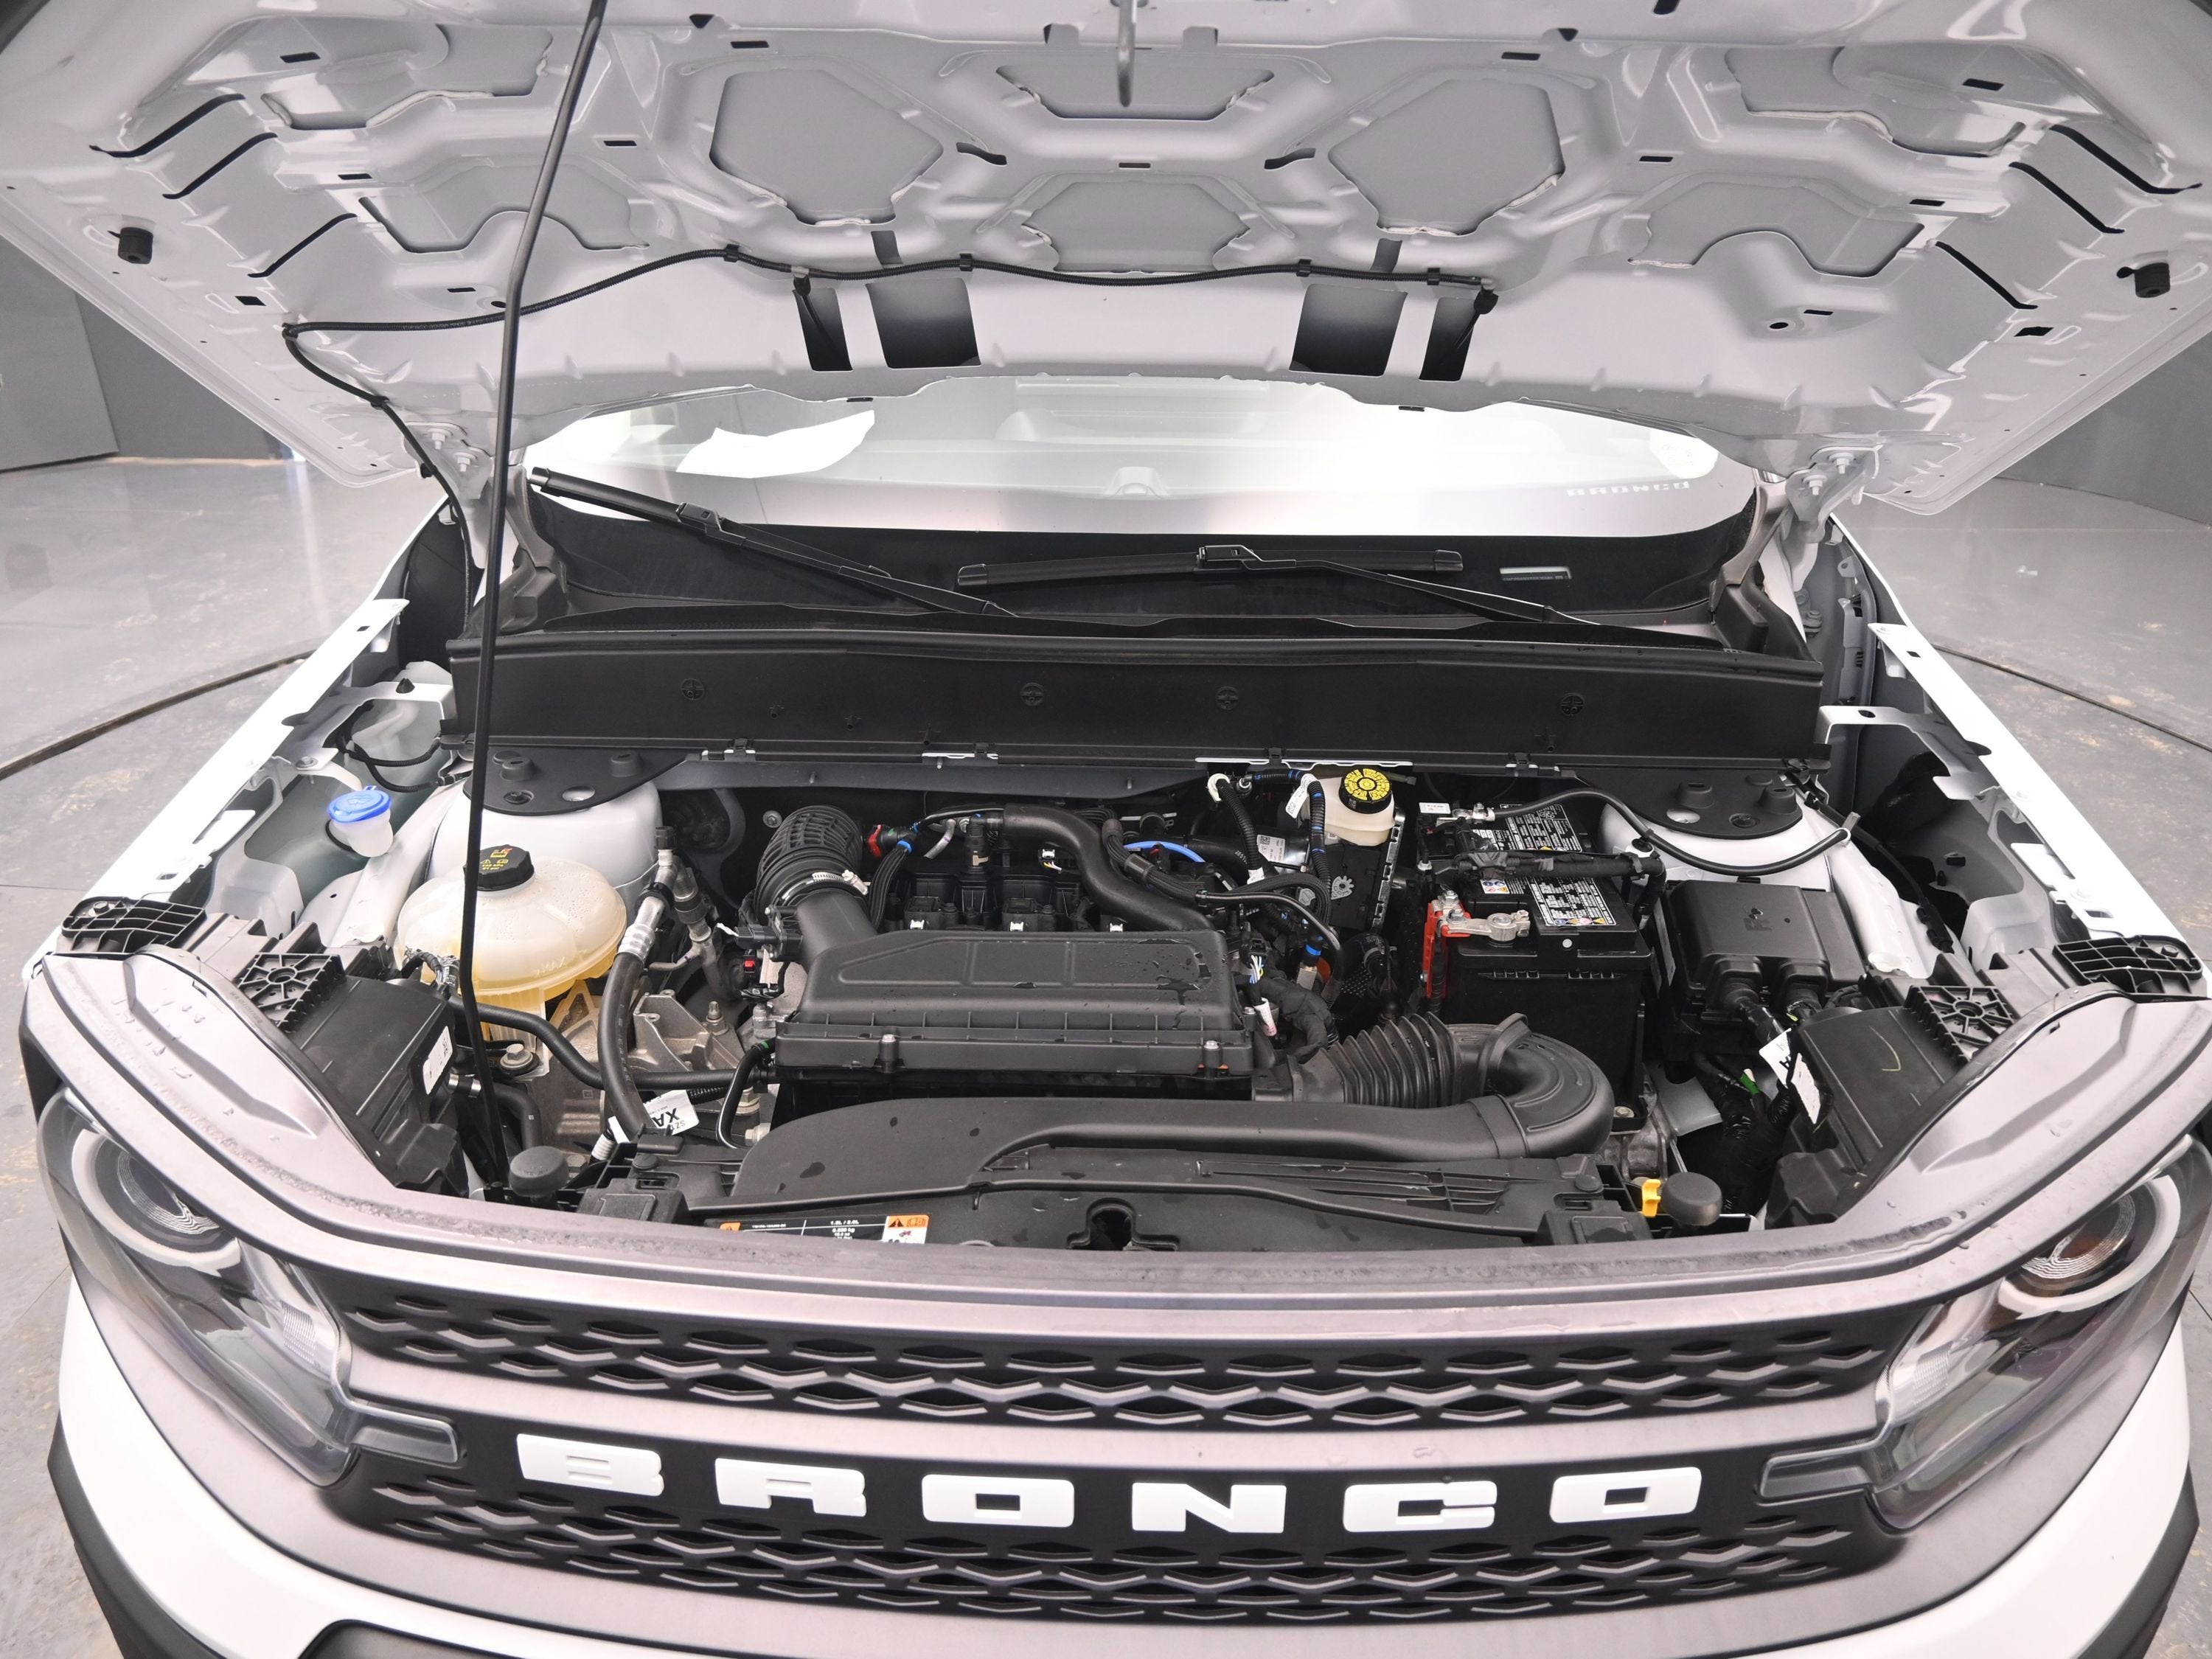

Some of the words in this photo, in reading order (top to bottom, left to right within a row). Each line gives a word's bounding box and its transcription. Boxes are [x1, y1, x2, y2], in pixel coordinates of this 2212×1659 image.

[1567, 481, 1689, 497] BRONCO
[652, 1107, 680, 1127] XA
[517, 1433, 1702, 1533] BRONCO
